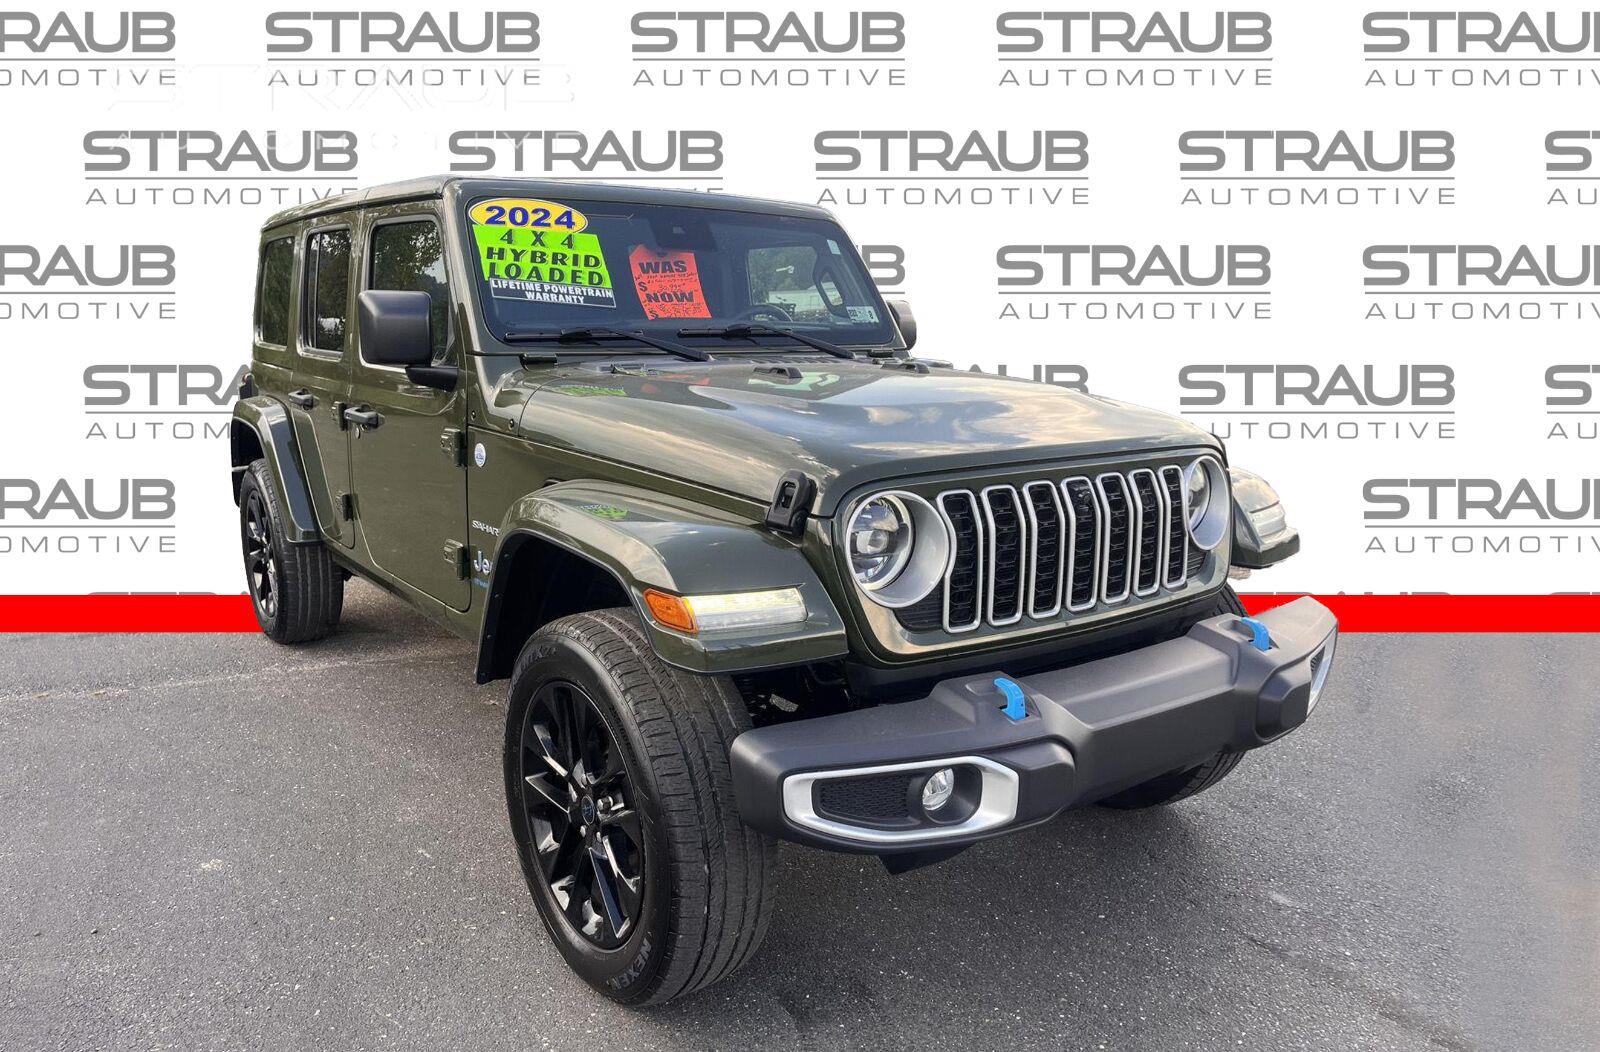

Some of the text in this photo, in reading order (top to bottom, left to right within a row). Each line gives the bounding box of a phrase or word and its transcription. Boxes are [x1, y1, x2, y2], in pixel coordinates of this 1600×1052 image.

[485, 205, 575, 229] 2024
[500, 229, 574, 249] 4 X 4
[486, 247, 600, 268] HYBRID
[488, 262, 603, 286] LOADED
[639, 260, 687, 274] WAS
[492, 280, 613, 298] LIFETIME POWERTRAIN
[525, 291, 585, 304] WARRANTY
[645, 290, 694, 303] NOW
[472, 520, 500, 537] SAHAR
